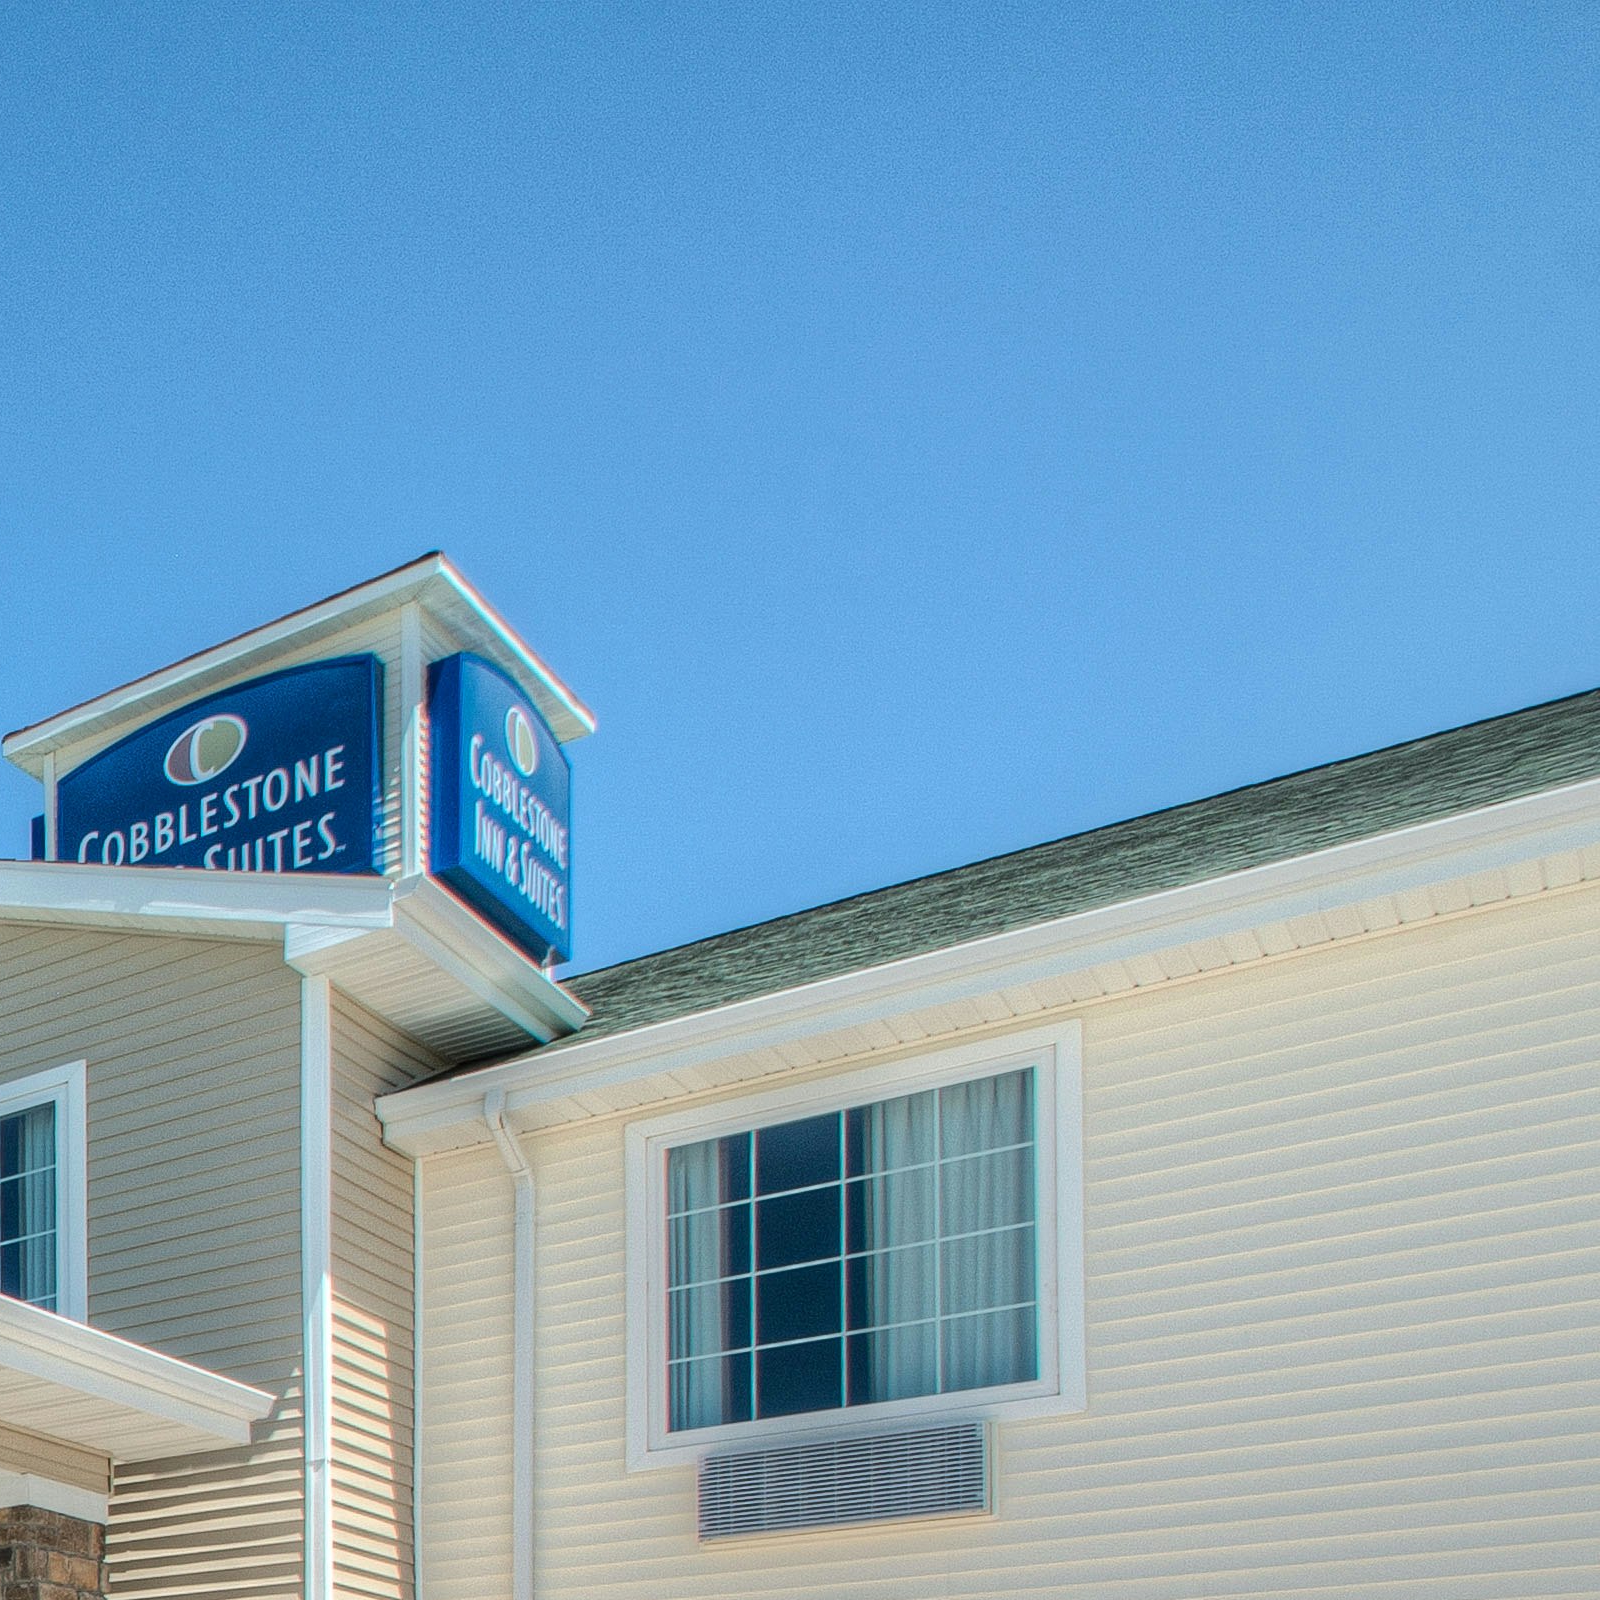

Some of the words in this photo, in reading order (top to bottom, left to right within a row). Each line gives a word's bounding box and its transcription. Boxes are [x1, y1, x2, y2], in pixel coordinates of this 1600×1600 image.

[78, 745, 346, 866] COBBLESTONE
[469, 733, 568, 870] COBBLESTONE
[474, 798, 506, 874] INN
[505, 835, 519, 887] &
[519, 840, 566, 930] SUITES
